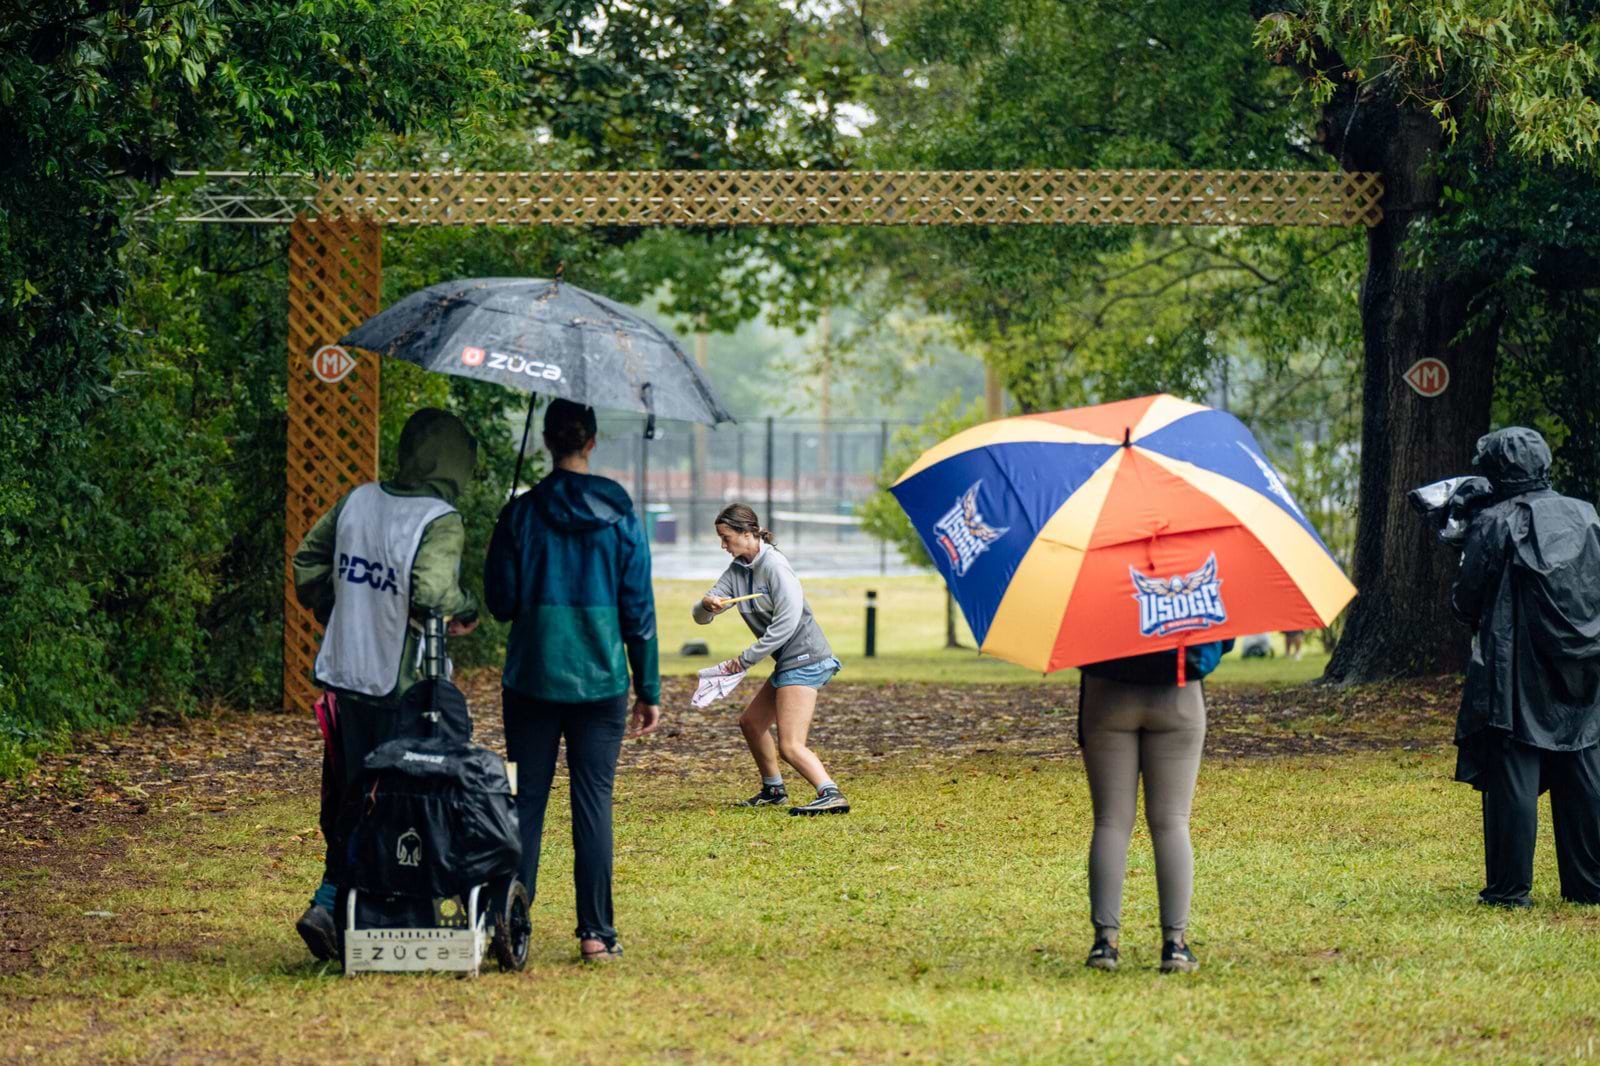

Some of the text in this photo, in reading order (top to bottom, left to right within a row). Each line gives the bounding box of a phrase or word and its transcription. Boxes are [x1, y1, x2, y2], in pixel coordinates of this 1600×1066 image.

[322, 352, 338, 375] M
[1422, 366, 1439, 389] M
[1135, 580, 1226, 633] USDGC
